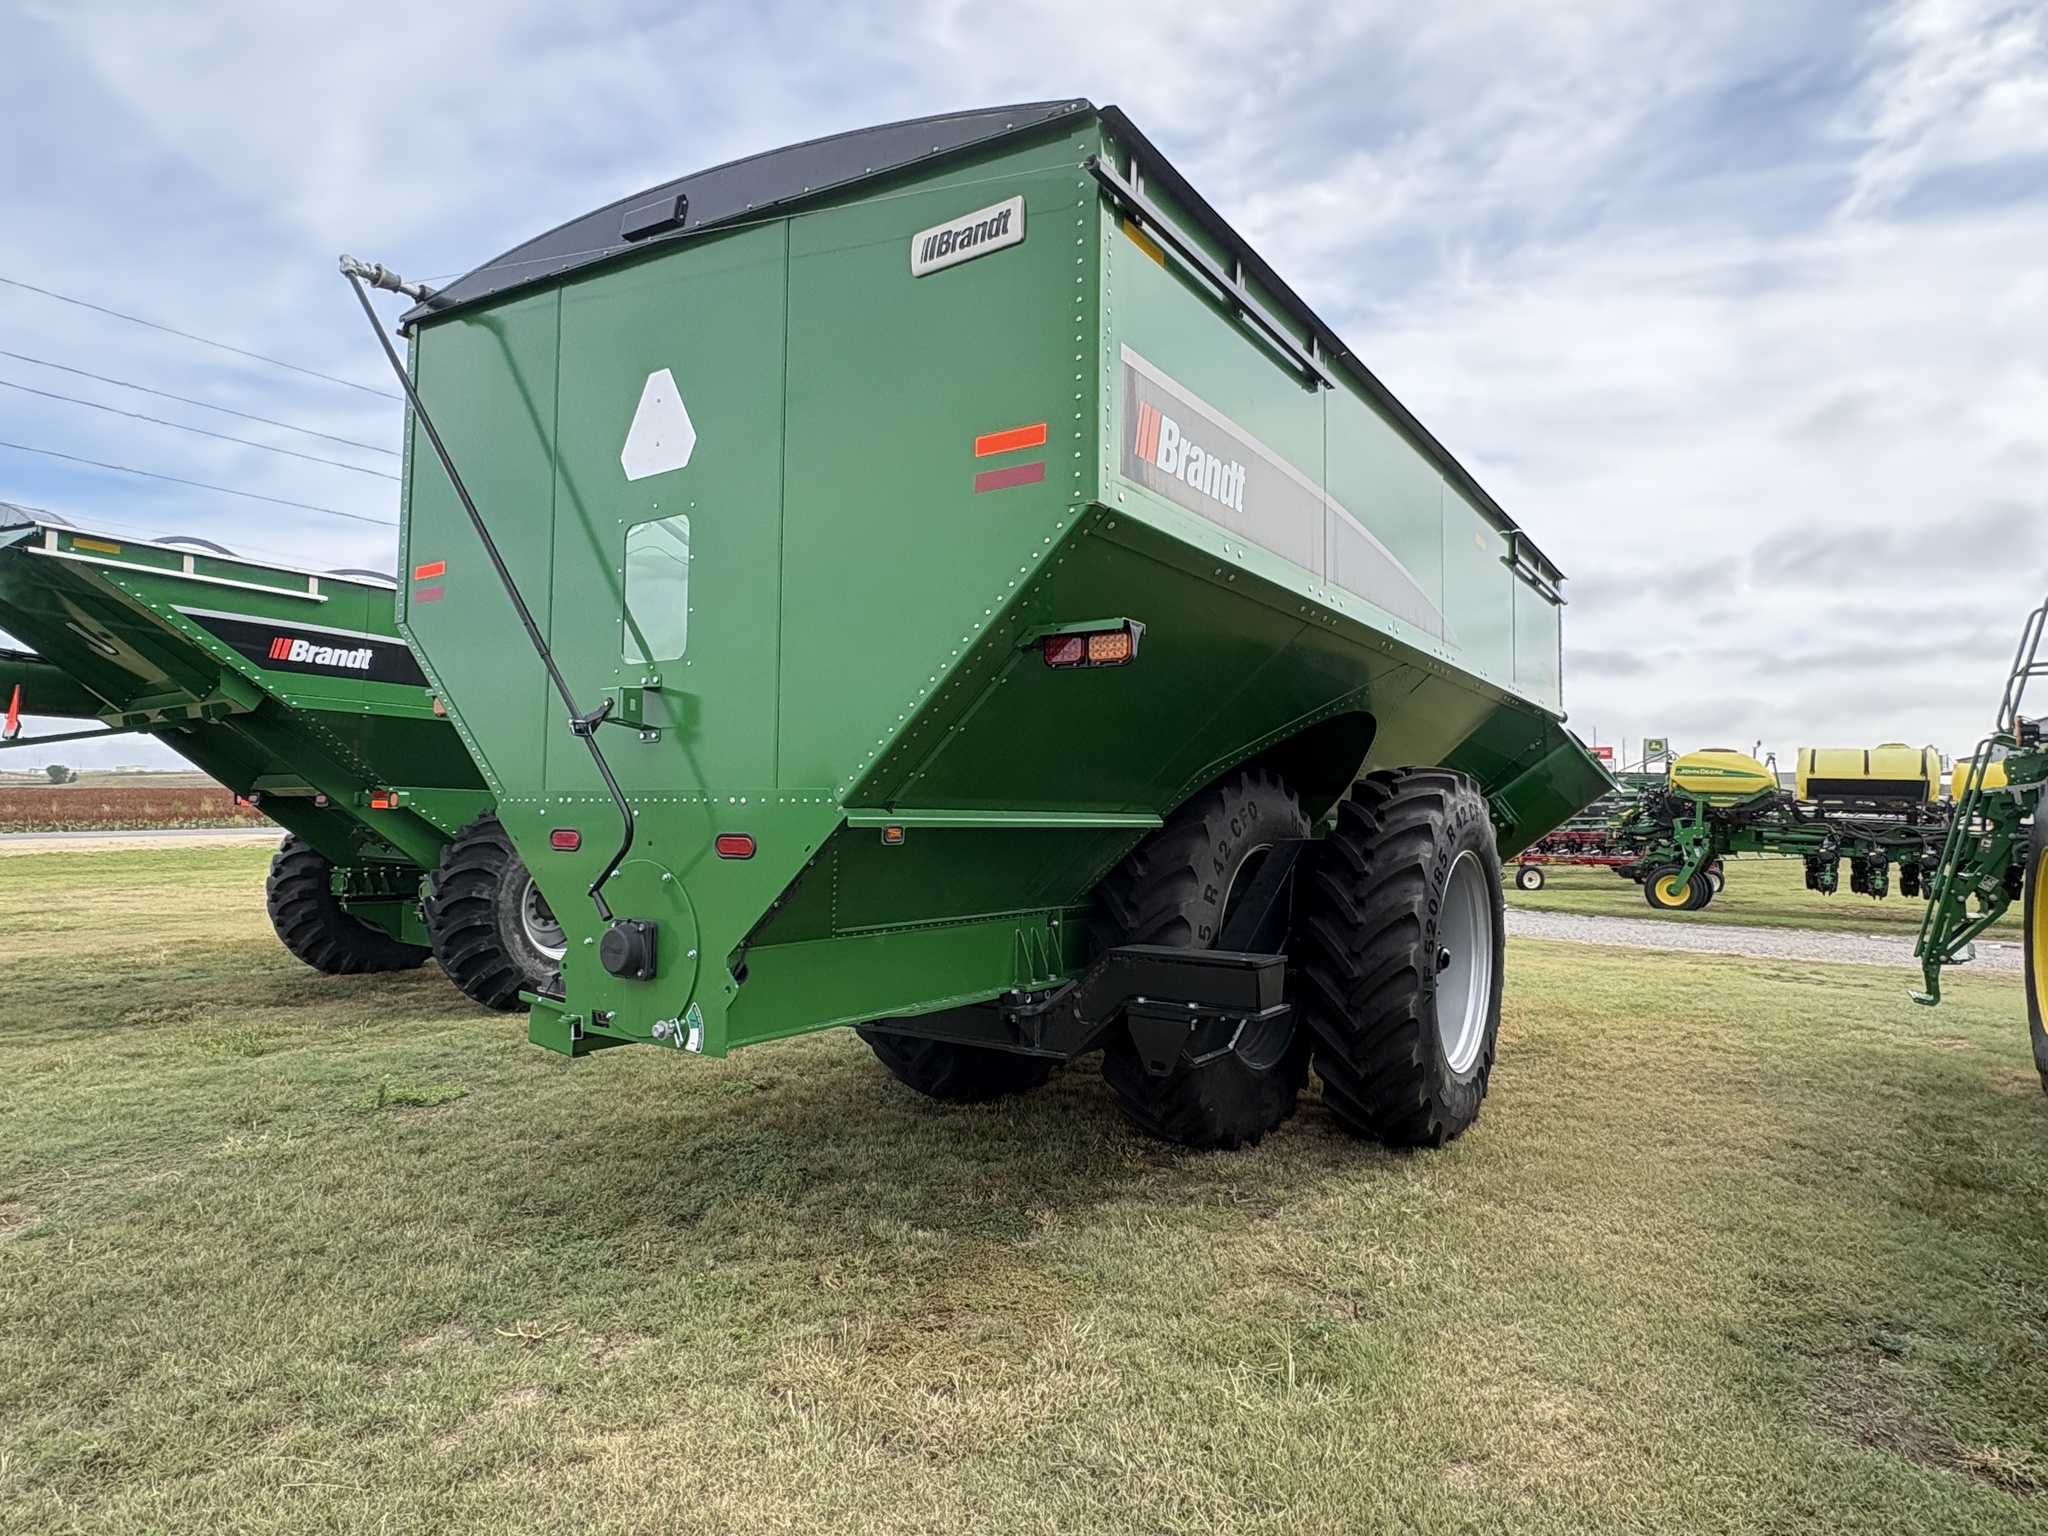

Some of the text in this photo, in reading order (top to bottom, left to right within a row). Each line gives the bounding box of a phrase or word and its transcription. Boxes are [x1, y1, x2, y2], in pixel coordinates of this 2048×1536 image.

[936, 208, 1012, 259] Brandt
[1156, 414, 1246, 513] Brandt
[287, 638, 373, 670] Brandt
[1425, 848, 1448, 956] 520/85
